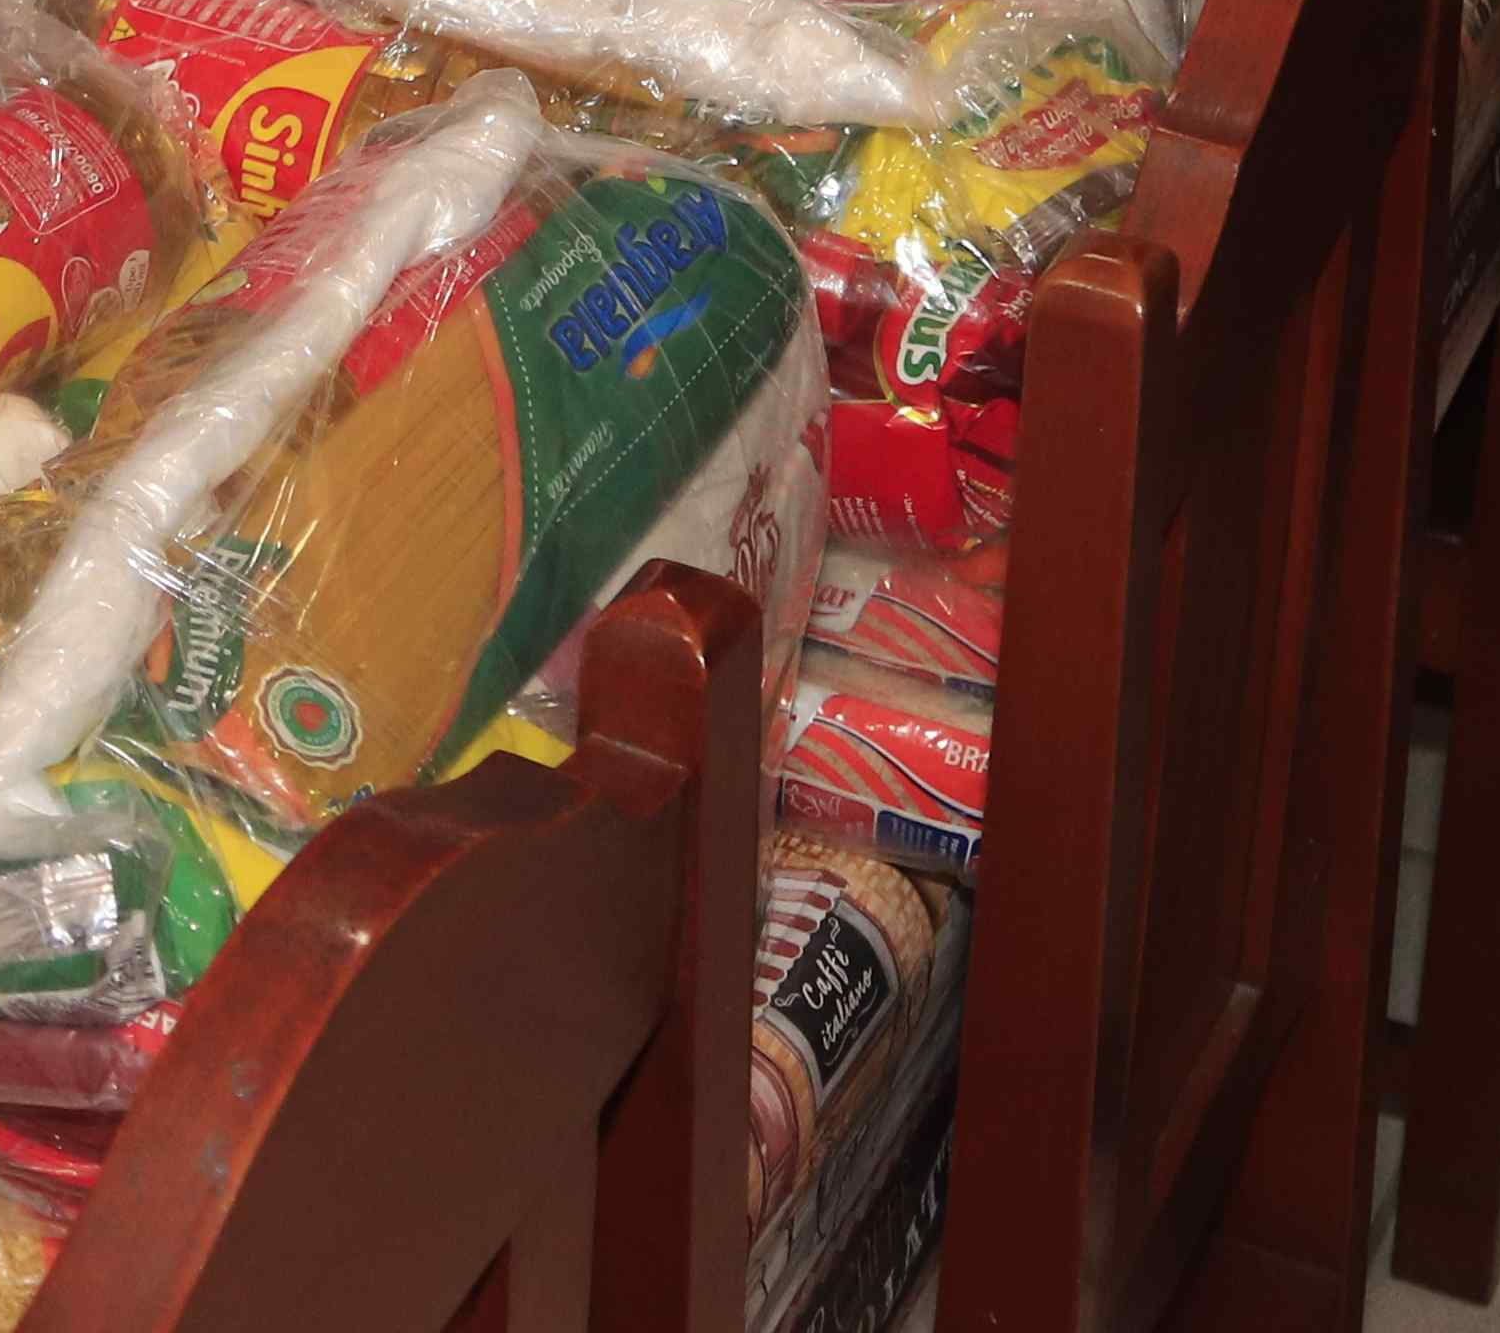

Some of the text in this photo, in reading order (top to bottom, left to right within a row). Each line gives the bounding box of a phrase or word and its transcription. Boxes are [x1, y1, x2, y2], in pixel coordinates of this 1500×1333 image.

[240, 104, 302, 217] Sinh
[516, 232, 604, 312] Espaguete
[549, 185, 730, 374] Araguaia
[801, 941, 853, 1013] Caffè
[820, 963, 875, 1052] italiano
